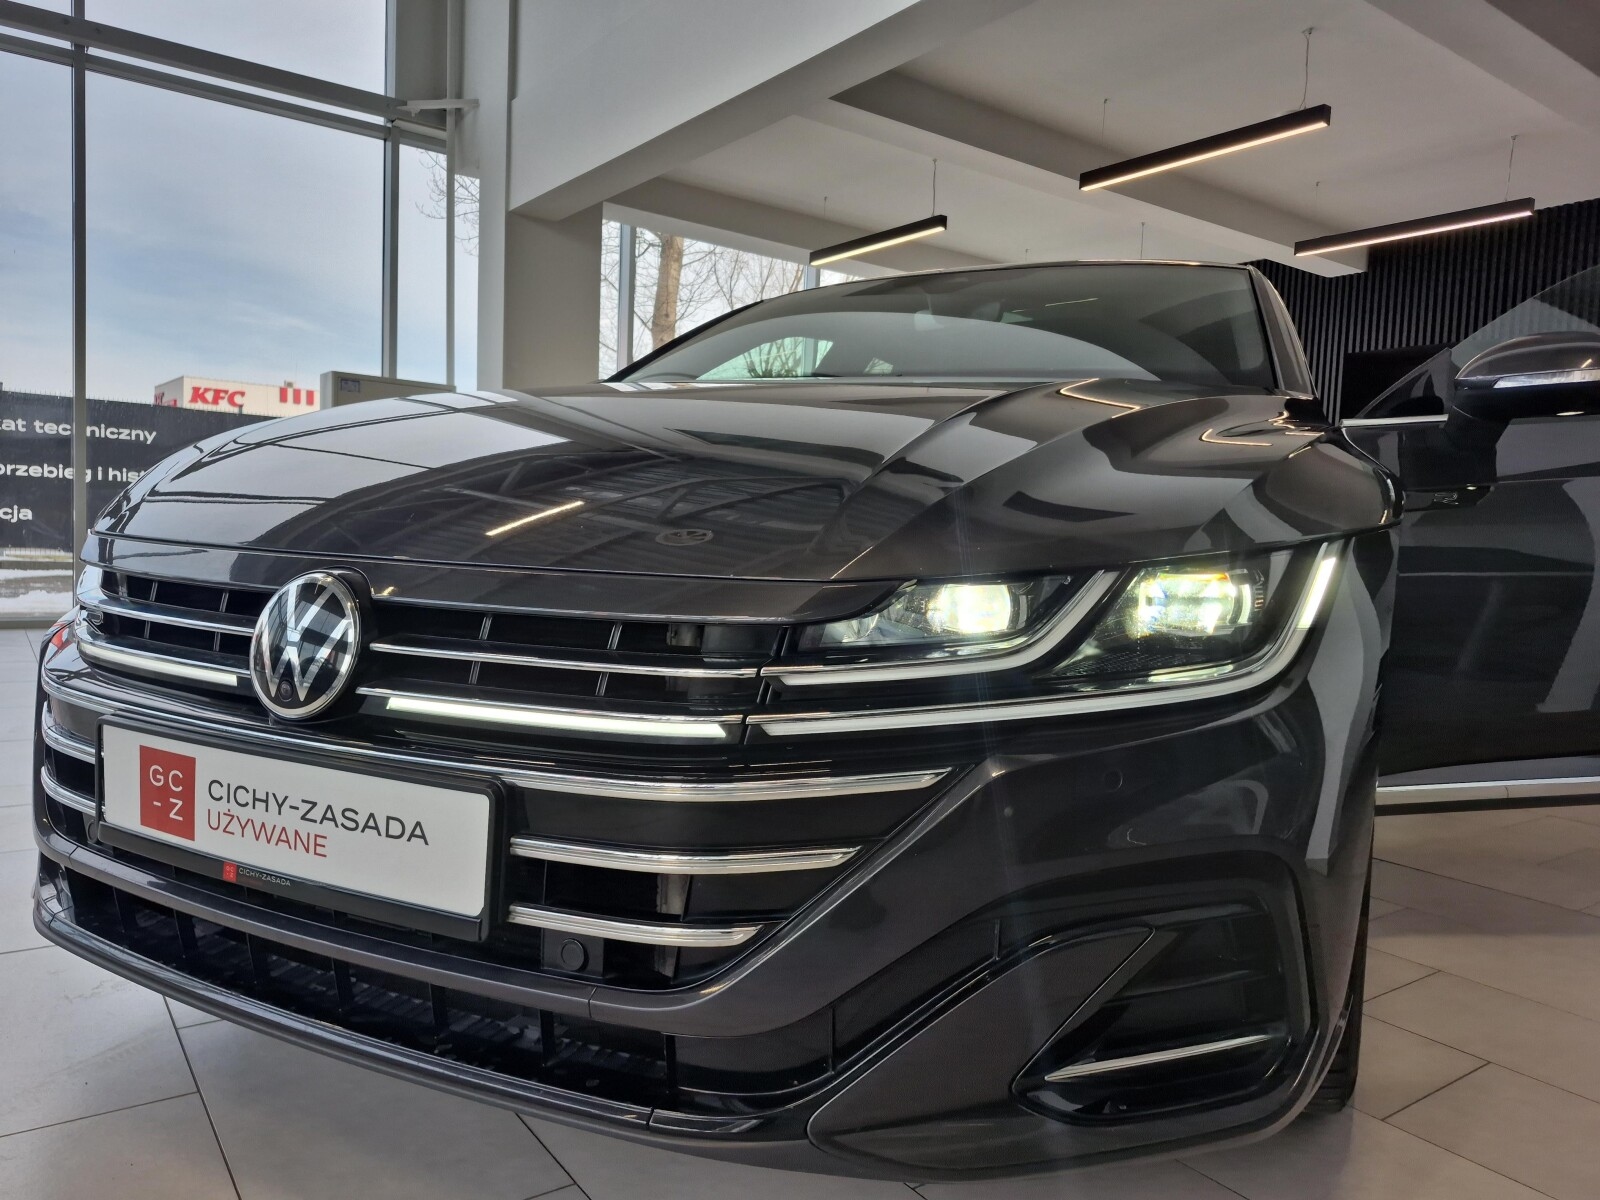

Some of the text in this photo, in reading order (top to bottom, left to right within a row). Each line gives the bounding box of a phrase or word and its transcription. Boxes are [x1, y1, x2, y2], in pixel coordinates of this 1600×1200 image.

[189, 386, 246, 408] KFC
[0, 418, 156, 444] at tecniczny
[98, 466, 103, 481] i
[149, 764, 183, 792] GC
[208, 779, 430, 846] CICHY-ZASADA
[207, 808, 328, 858] UŻYWANE
[238, 867, 292, 887] CICHY-ZASADA
